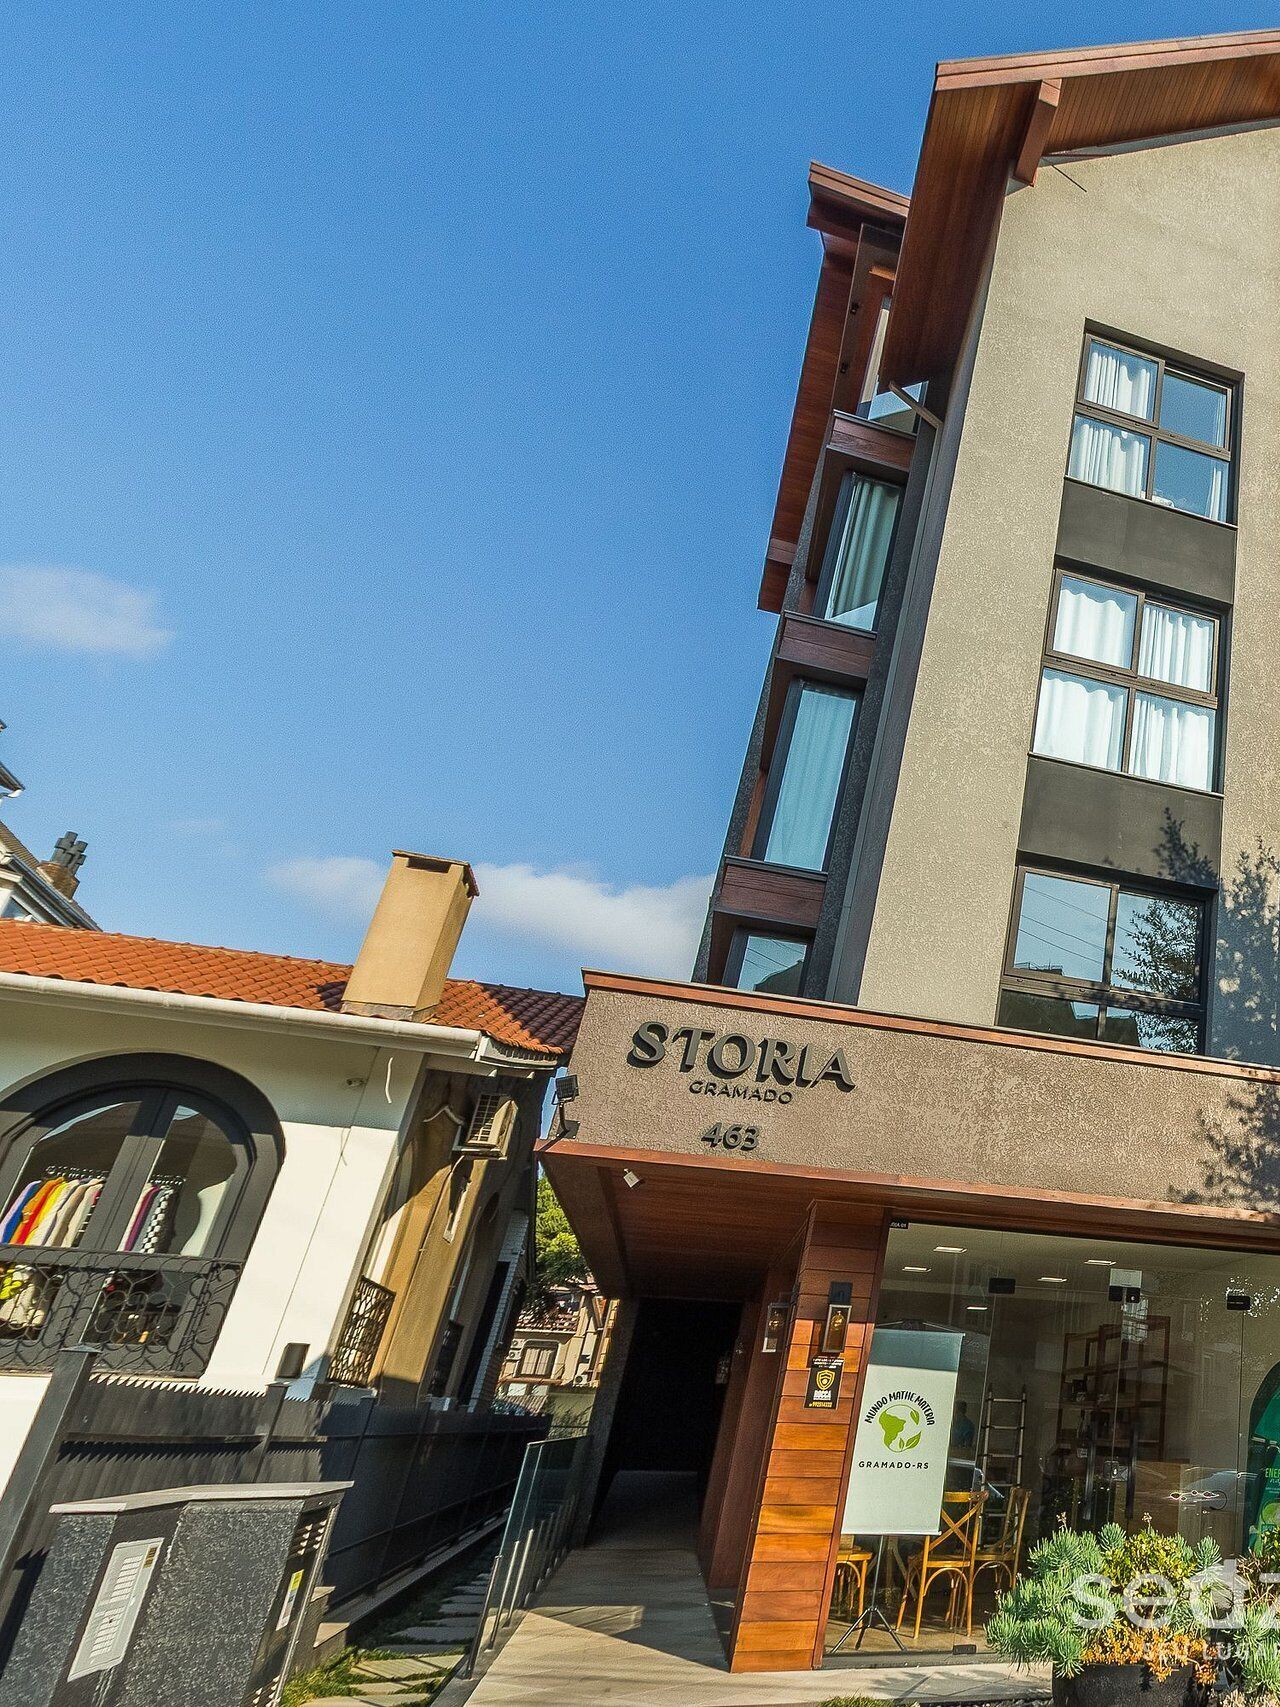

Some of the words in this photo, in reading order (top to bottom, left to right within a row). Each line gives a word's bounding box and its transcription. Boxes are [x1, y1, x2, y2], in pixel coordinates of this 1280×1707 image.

[628, 1021, 856, 1092] STORIA
[689, 1081, 793, 1104] GRAMADO
[701, 1122, 760, 1151] 463
[864, 1396, 888, 1424] MUNDO
